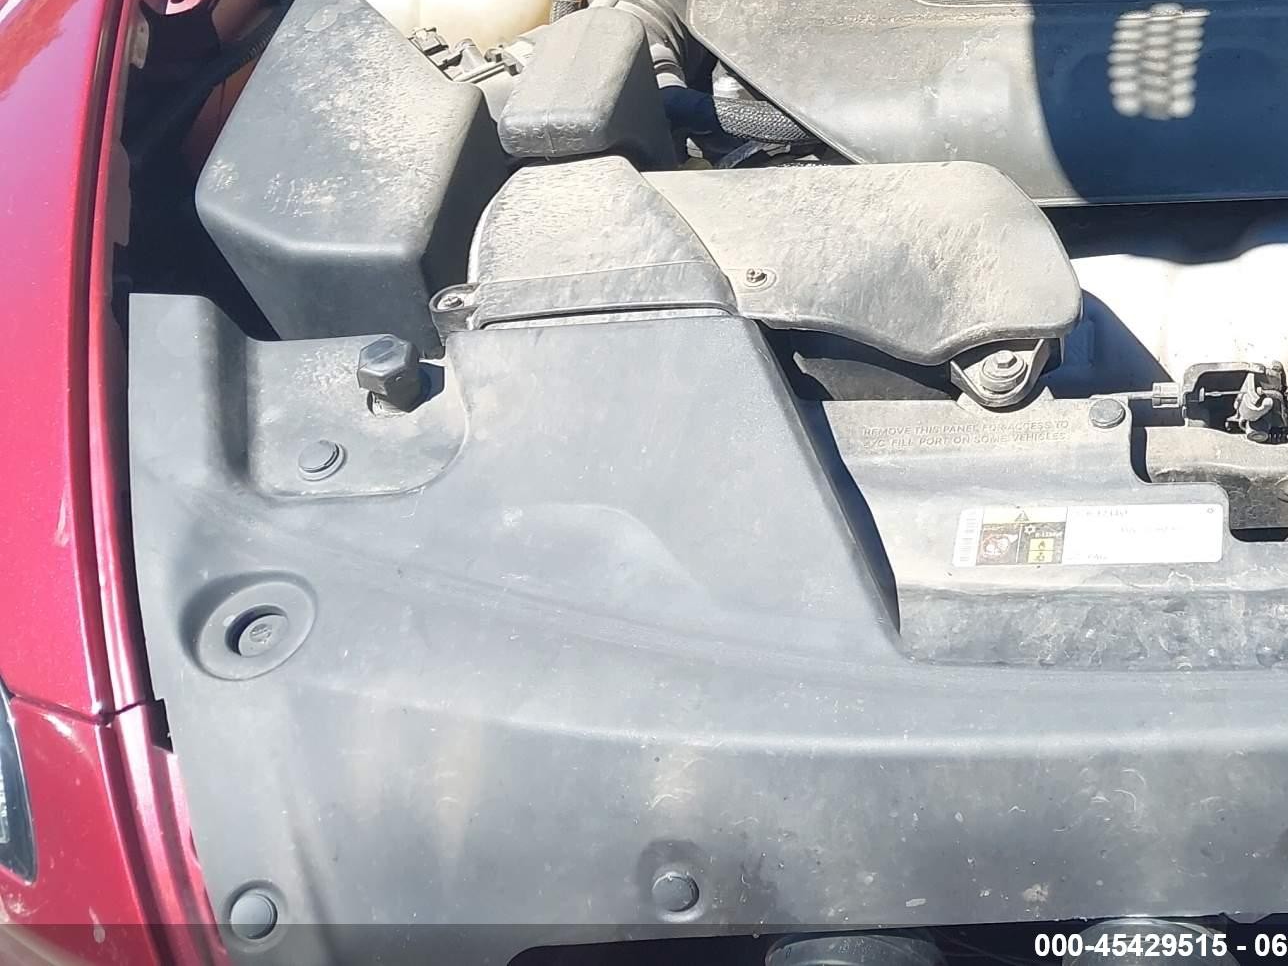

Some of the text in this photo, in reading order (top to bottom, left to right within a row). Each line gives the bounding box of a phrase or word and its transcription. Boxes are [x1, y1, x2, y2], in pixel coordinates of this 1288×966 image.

[863, 425, 911, 436] REMOVE
[915, 425, 939, 435] THIS
[943, 424, 979, 434] PANEL
[891, 437, 914, 447] FILL
[919, 436, 948, 446] PORT
[953, 436, 970, 445] ON
[974, 434, 1009, 444] SOME
